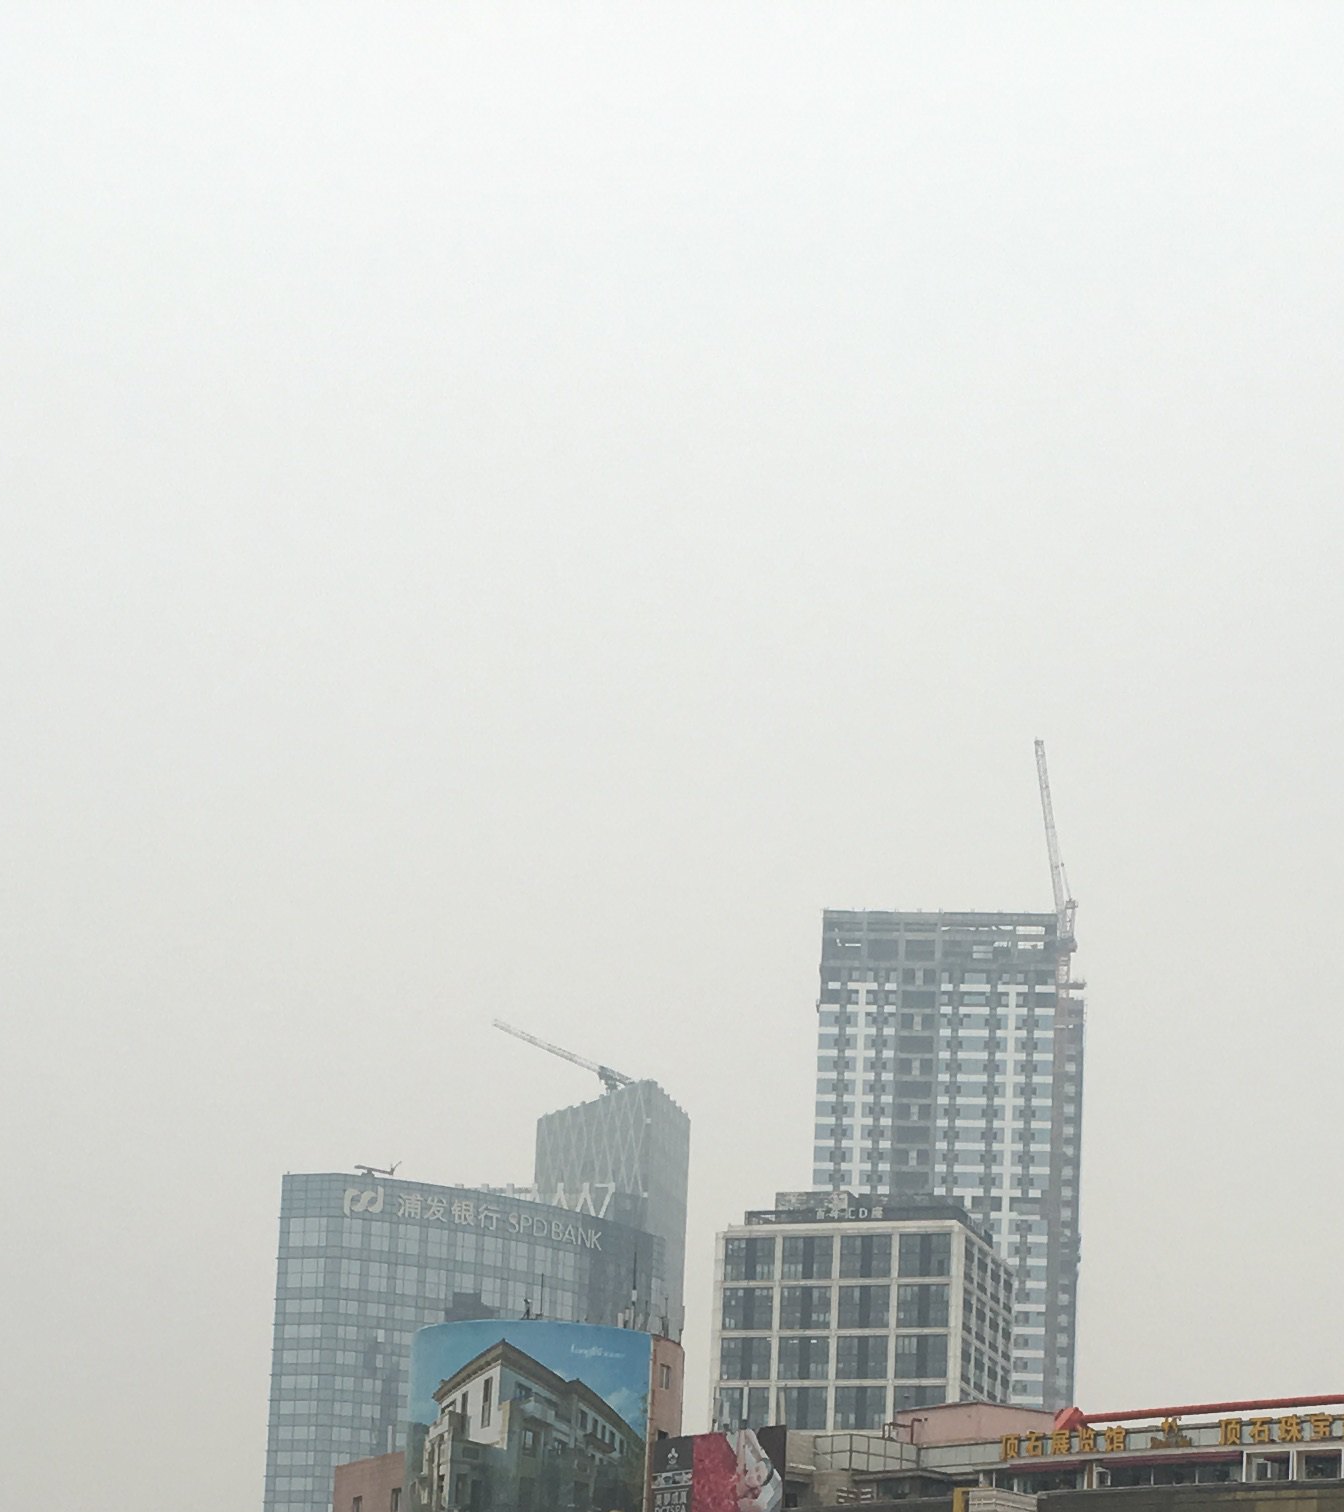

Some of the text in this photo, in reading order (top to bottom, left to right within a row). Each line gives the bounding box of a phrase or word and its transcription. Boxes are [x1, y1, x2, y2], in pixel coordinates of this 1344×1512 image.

[396, 1193, 501, 1231] 浦发银行
[1000, 1426, 1128, 1462] 顶石展览馆
